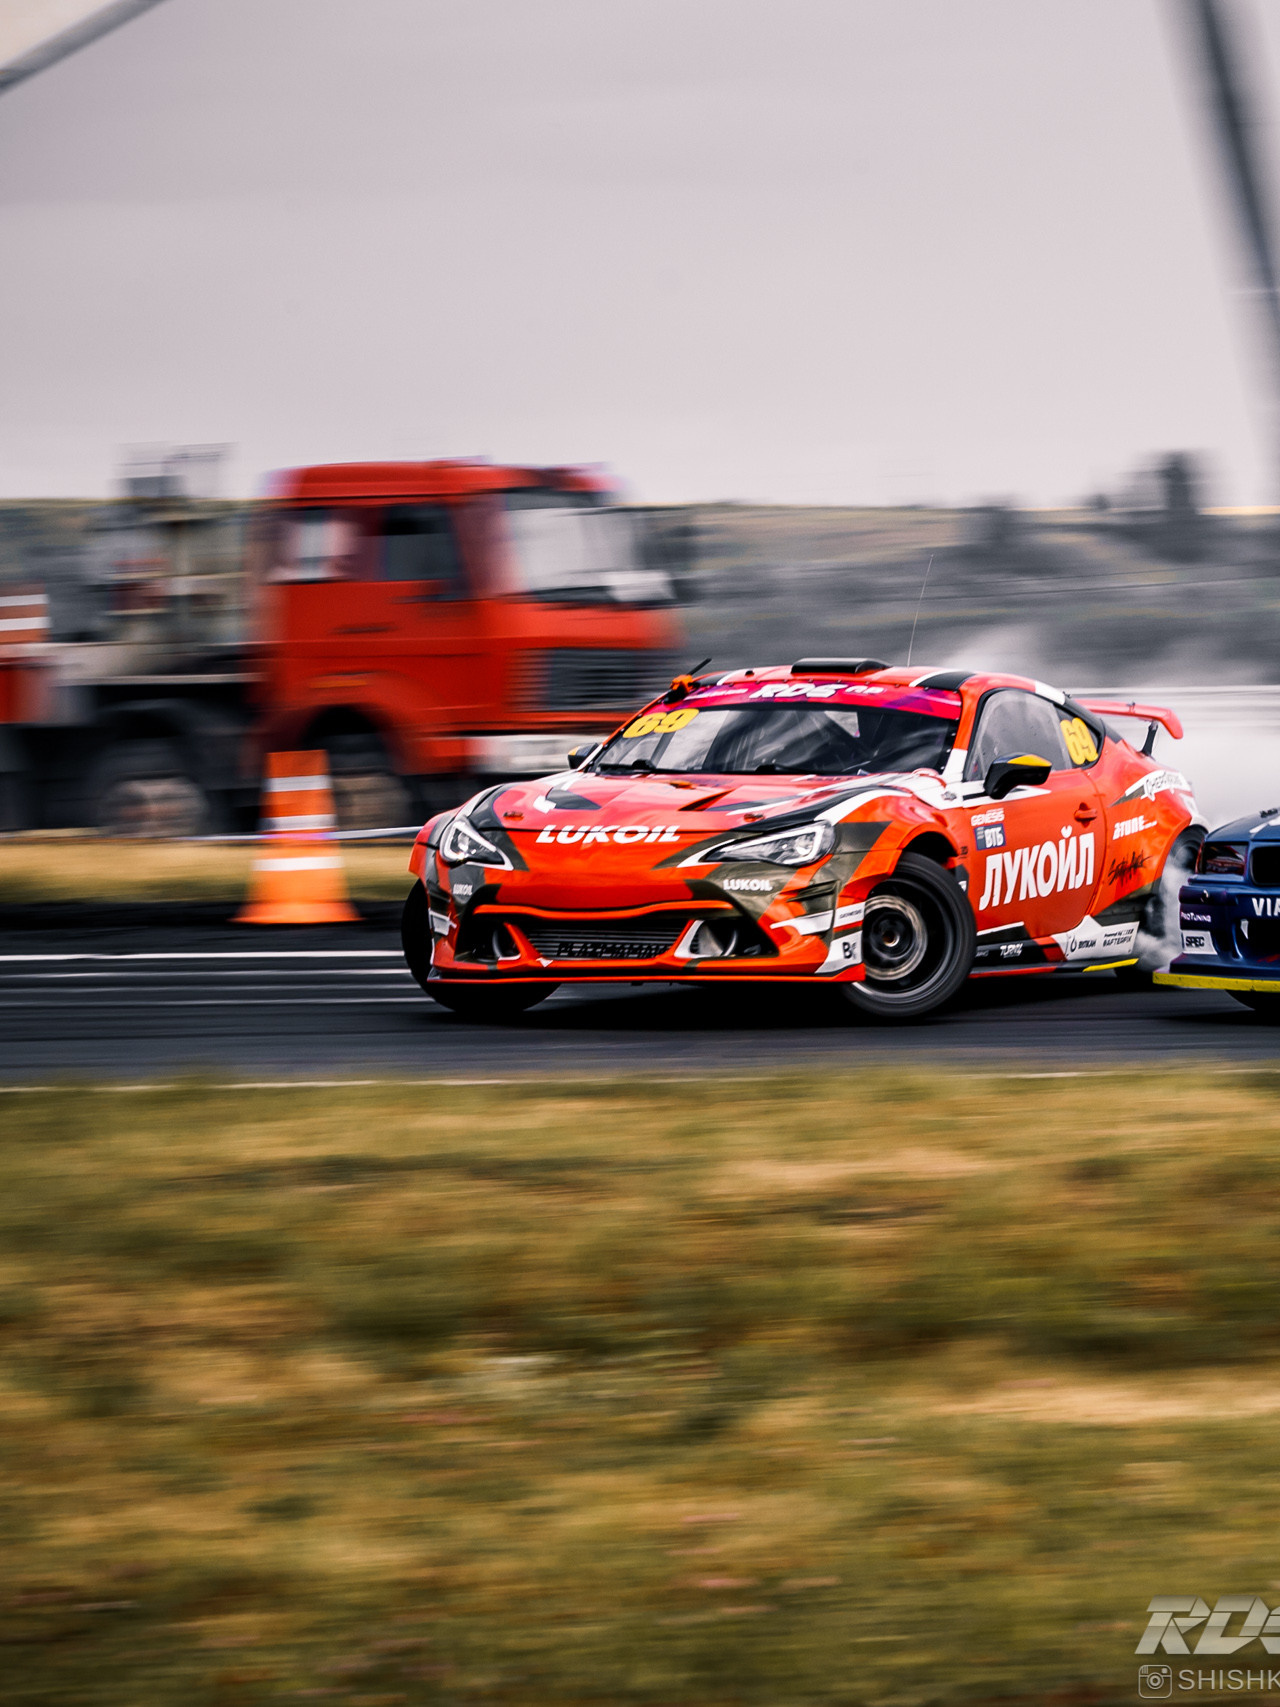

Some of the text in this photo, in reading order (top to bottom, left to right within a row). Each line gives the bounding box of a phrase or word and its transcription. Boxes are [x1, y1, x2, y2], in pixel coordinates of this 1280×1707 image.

[749, 684, 849, 698] RDS
[622, 708, 700, 738] 69
[1060, 717, 1099, 765] 69
[535, 824, 681, 844] LUKOIL
[984, 826, 1005, 848] ВТБ
[978, 825, 1095, 911] ЛУКОЙЛ
[723, 879, 773, 892] LUKOIL
[1185, 936, 1205, 948] SPEC
